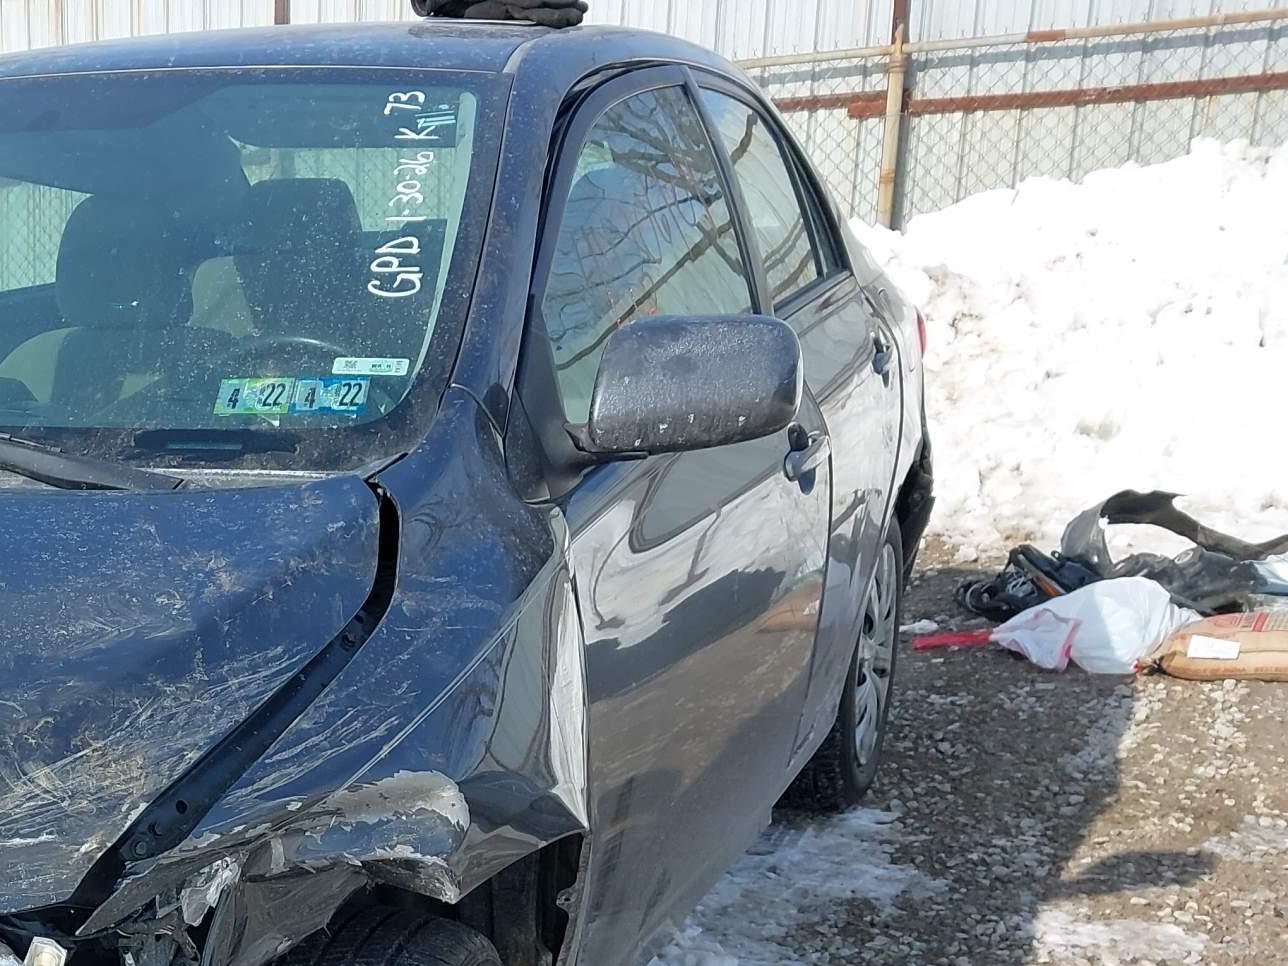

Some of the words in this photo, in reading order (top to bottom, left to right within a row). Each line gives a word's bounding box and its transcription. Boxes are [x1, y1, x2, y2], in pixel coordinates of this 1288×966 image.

[367, 236, 423, 298] GPD
[226, 388, 240, 409] 4
[262, 382, 286, 407] 22
[304, 388, 316, 409] 4
[339, 382, 363, 407] 22
